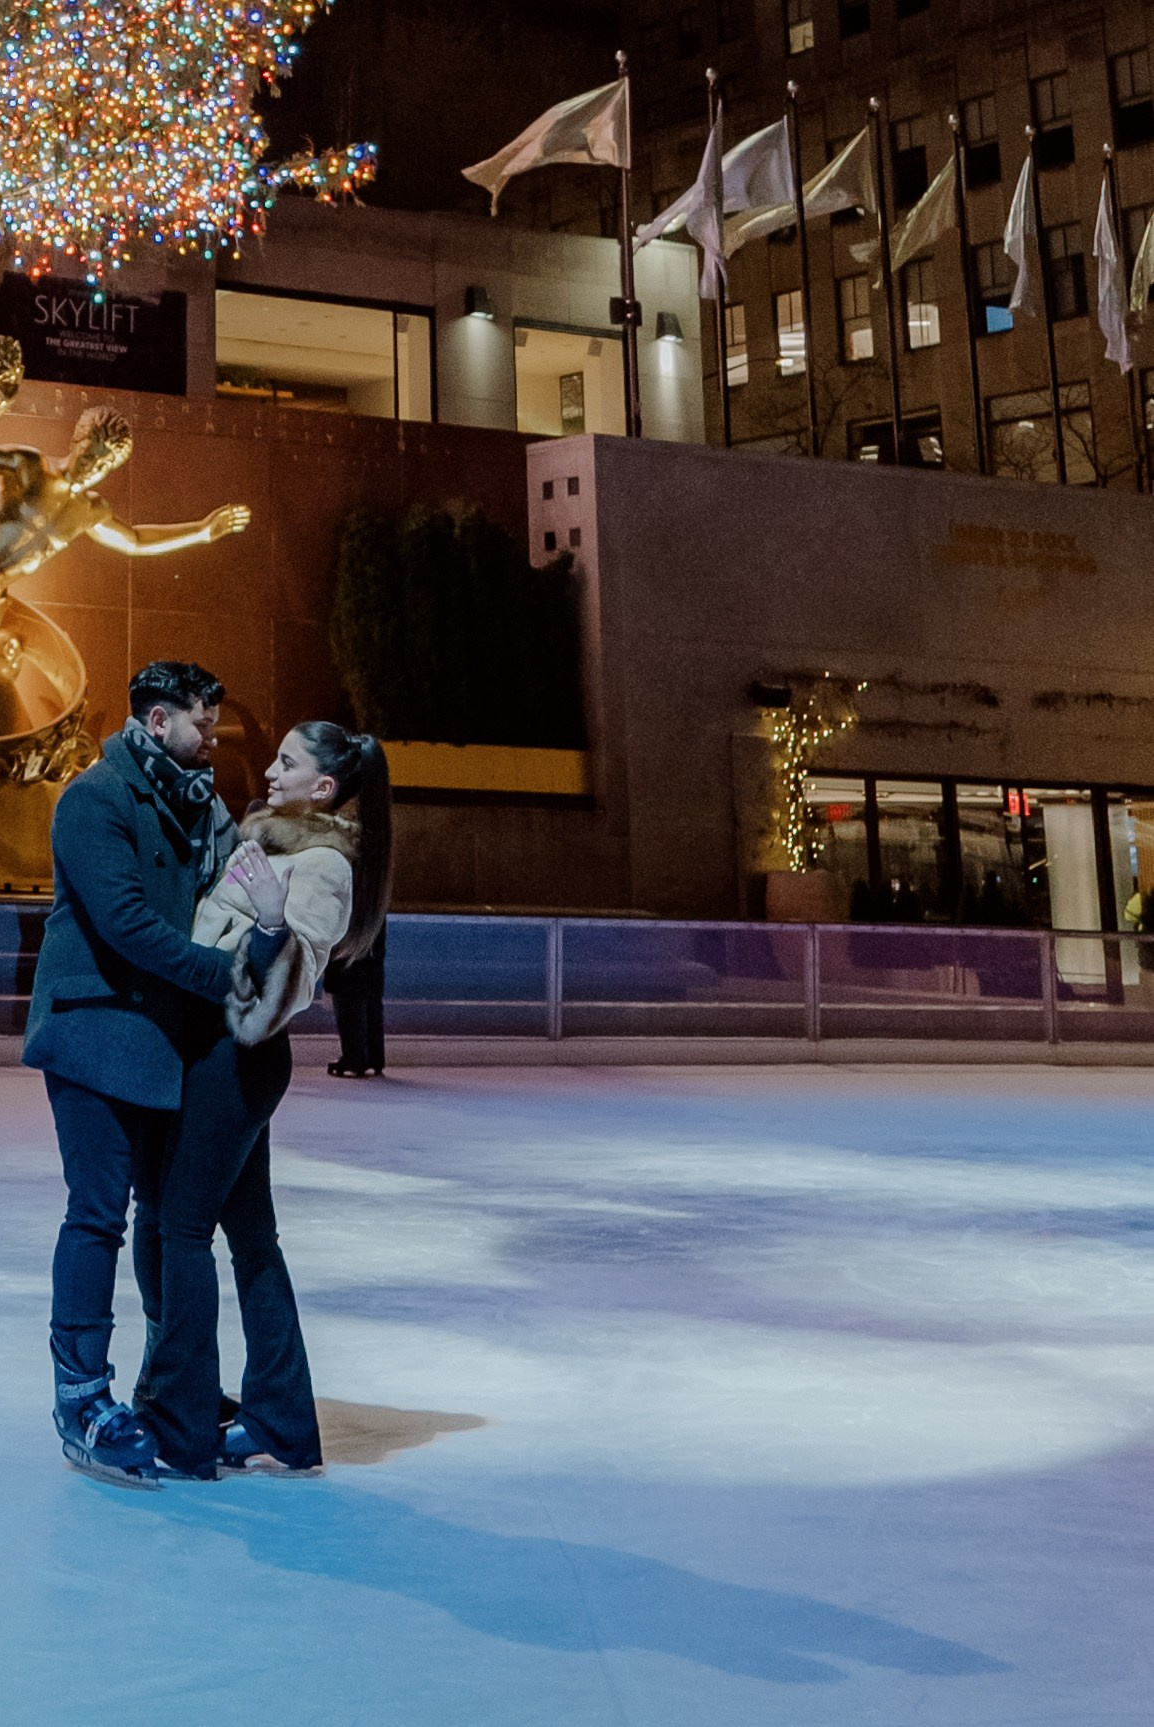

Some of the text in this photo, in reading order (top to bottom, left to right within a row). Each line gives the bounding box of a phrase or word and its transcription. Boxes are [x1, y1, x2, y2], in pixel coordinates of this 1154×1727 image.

[34, 294, 140, 333] SKYLIFT
[46, 336, 129, 353] THE GREATEST VIEW
[59, 330, 115, 344] WELCOME TO
[56, 346, 117, 362] IN THE WORLD
